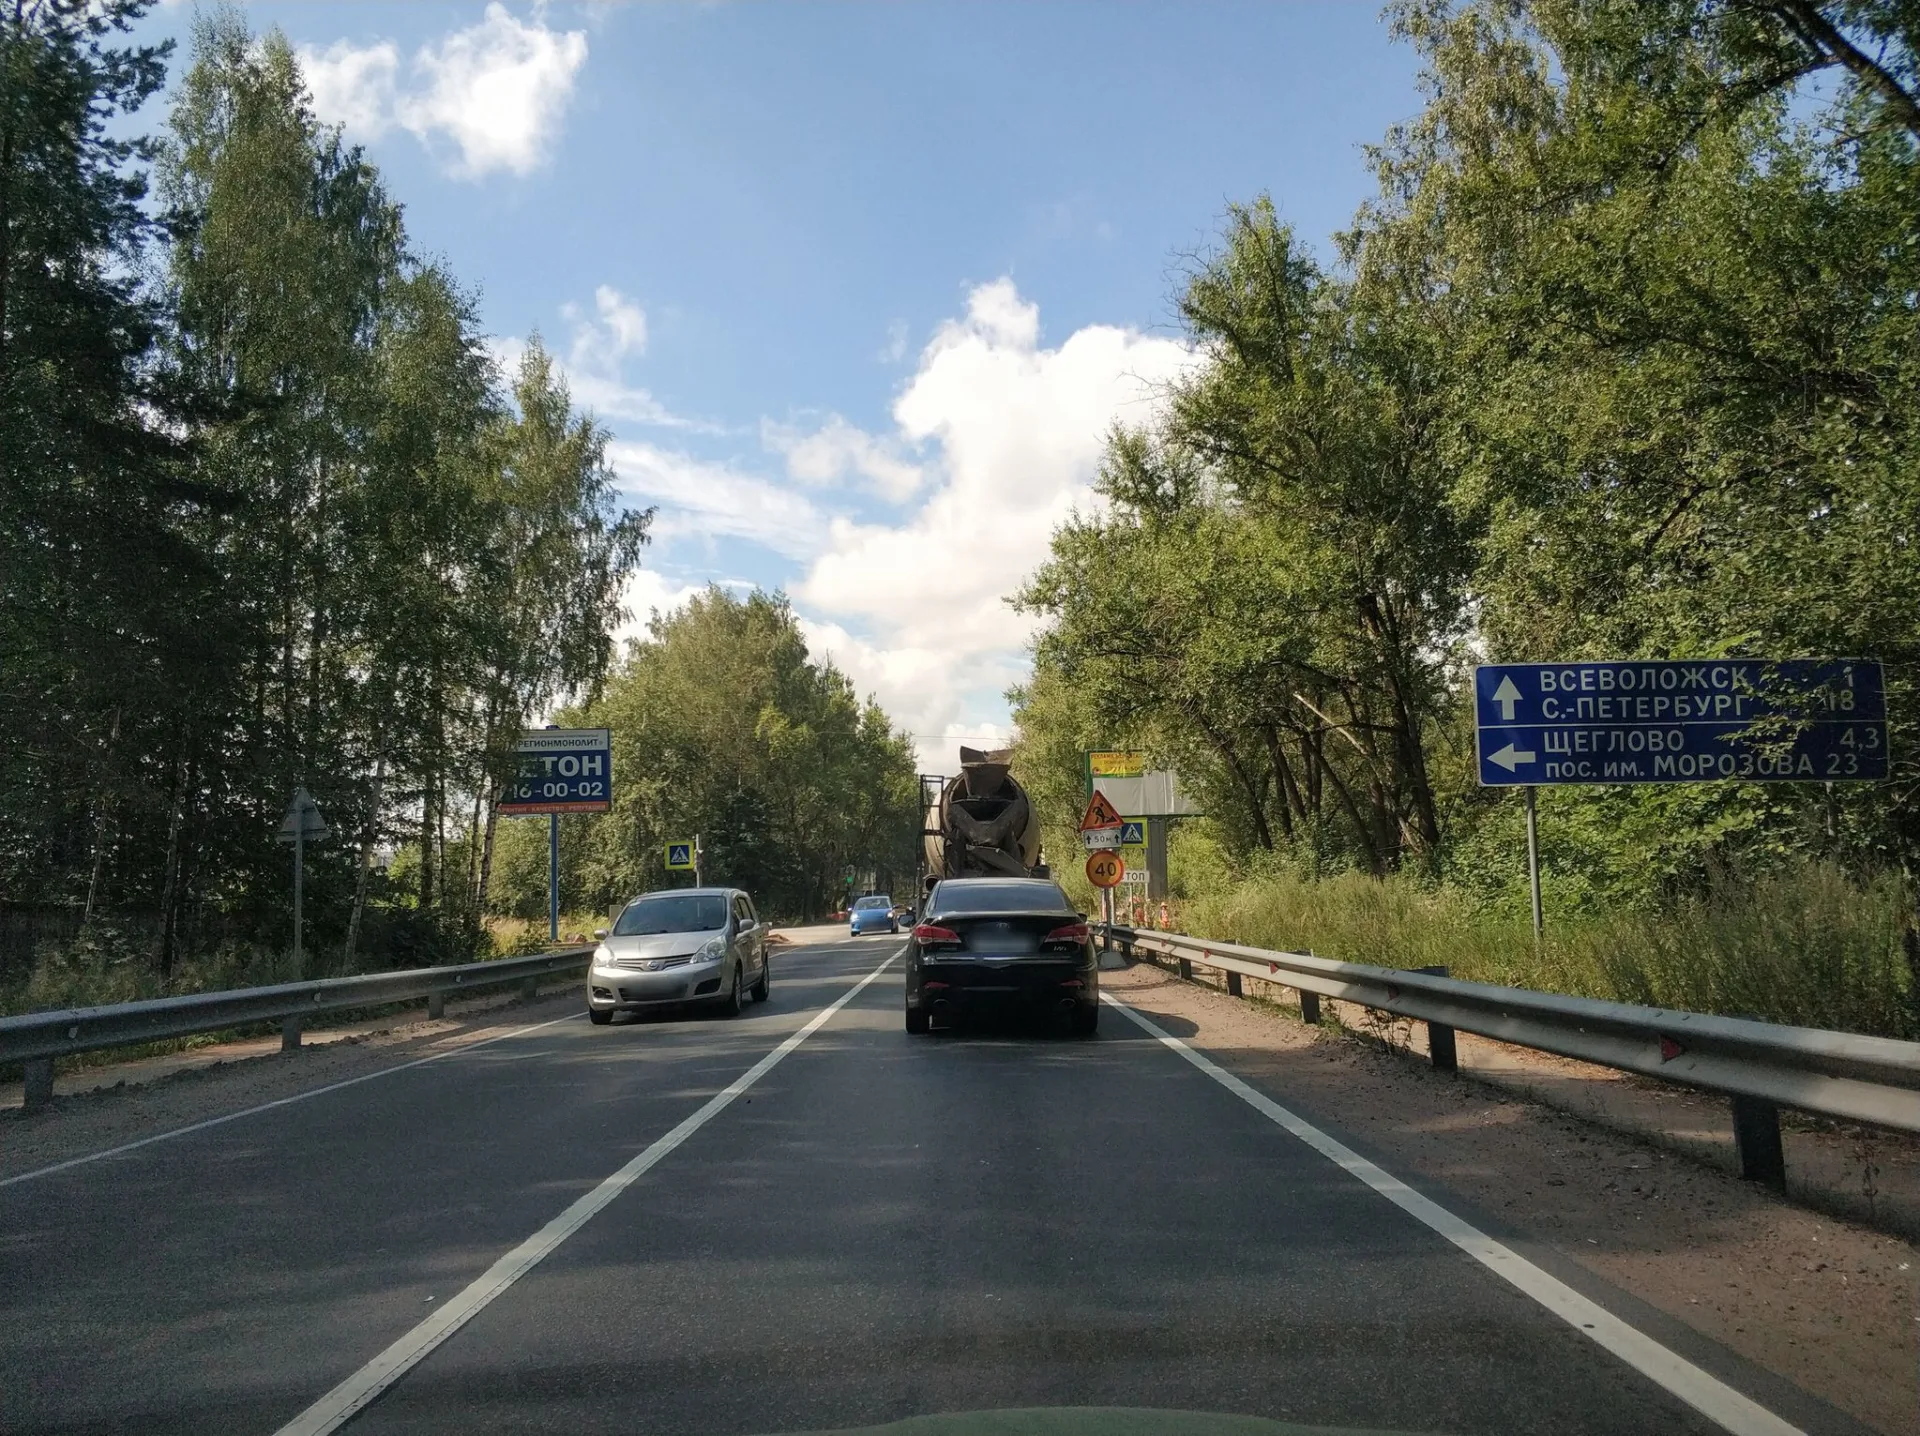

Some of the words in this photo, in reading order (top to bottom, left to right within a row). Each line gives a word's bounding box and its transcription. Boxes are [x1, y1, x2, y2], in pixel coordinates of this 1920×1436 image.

[1540, 667, 1748, 692] ВСЕВОЛОЖСК
[1541, 694, 1750, 720] С.-ПЕТЕРБУРГ
[1543, 730, 1684, 755] ЩЕГЛОВО
[1840, 728, 1880, 752] 4,3
[1653, 754, 1814, 777] МОРОЗОВА
[1826, 753, 1859, 775] 23
[1095, 862, 1117, 877] 40
[1123, 872, 1145, 881] ТОП
